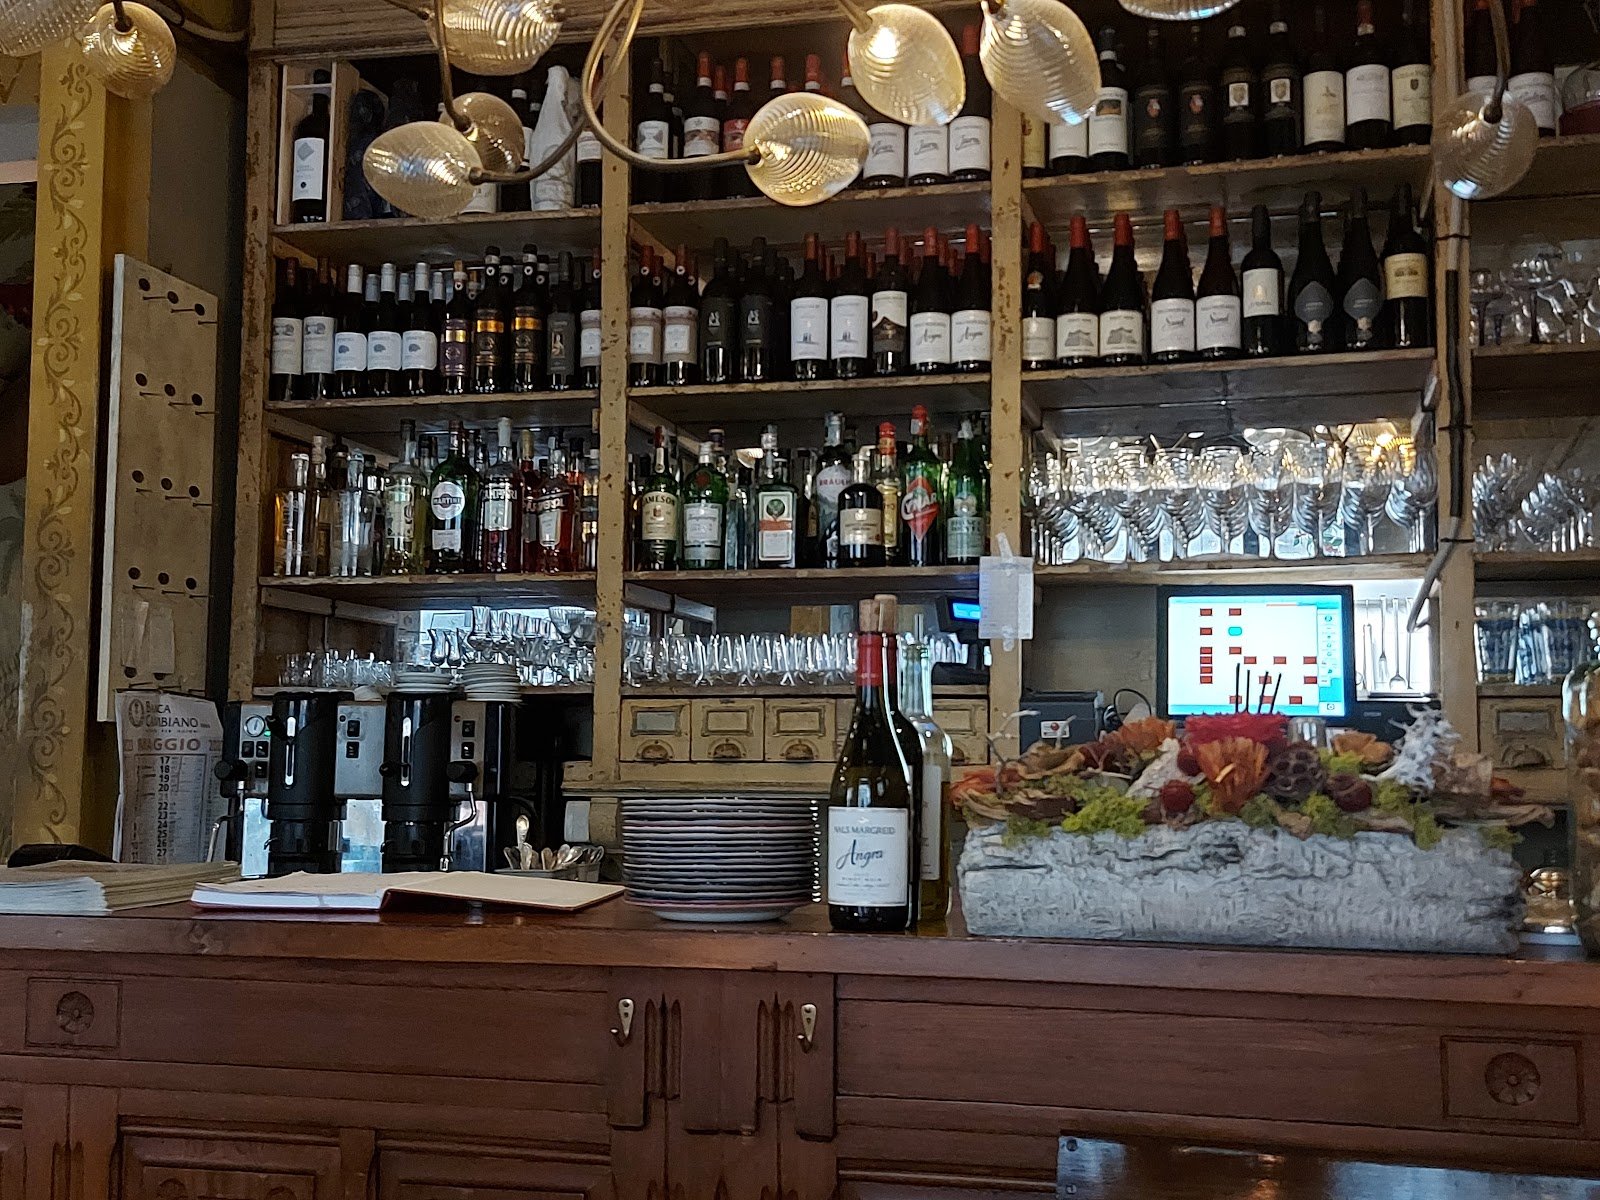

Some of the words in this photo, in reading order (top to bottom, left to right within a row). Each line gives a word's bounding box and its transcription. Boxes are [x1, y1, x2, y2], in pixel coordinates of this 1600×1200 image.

[433, 497, 461, 505] MARTINI
[644, 495, 675, 506] AMESON
[137, 738, 201, 751] MAGGIO
[160, 755, 171, 764] 17
[160, 765, 170, 773] 18
[159, 774, 170, 783] 19
[158, 783, 170, 792] 20
[158, 802, 169, 810] 22
[157, 811, 168, 820] 23
[157, 829, 168, 838] 25
[156, 839, 167, 848] 26
[156, 848, 167, 857] 27
